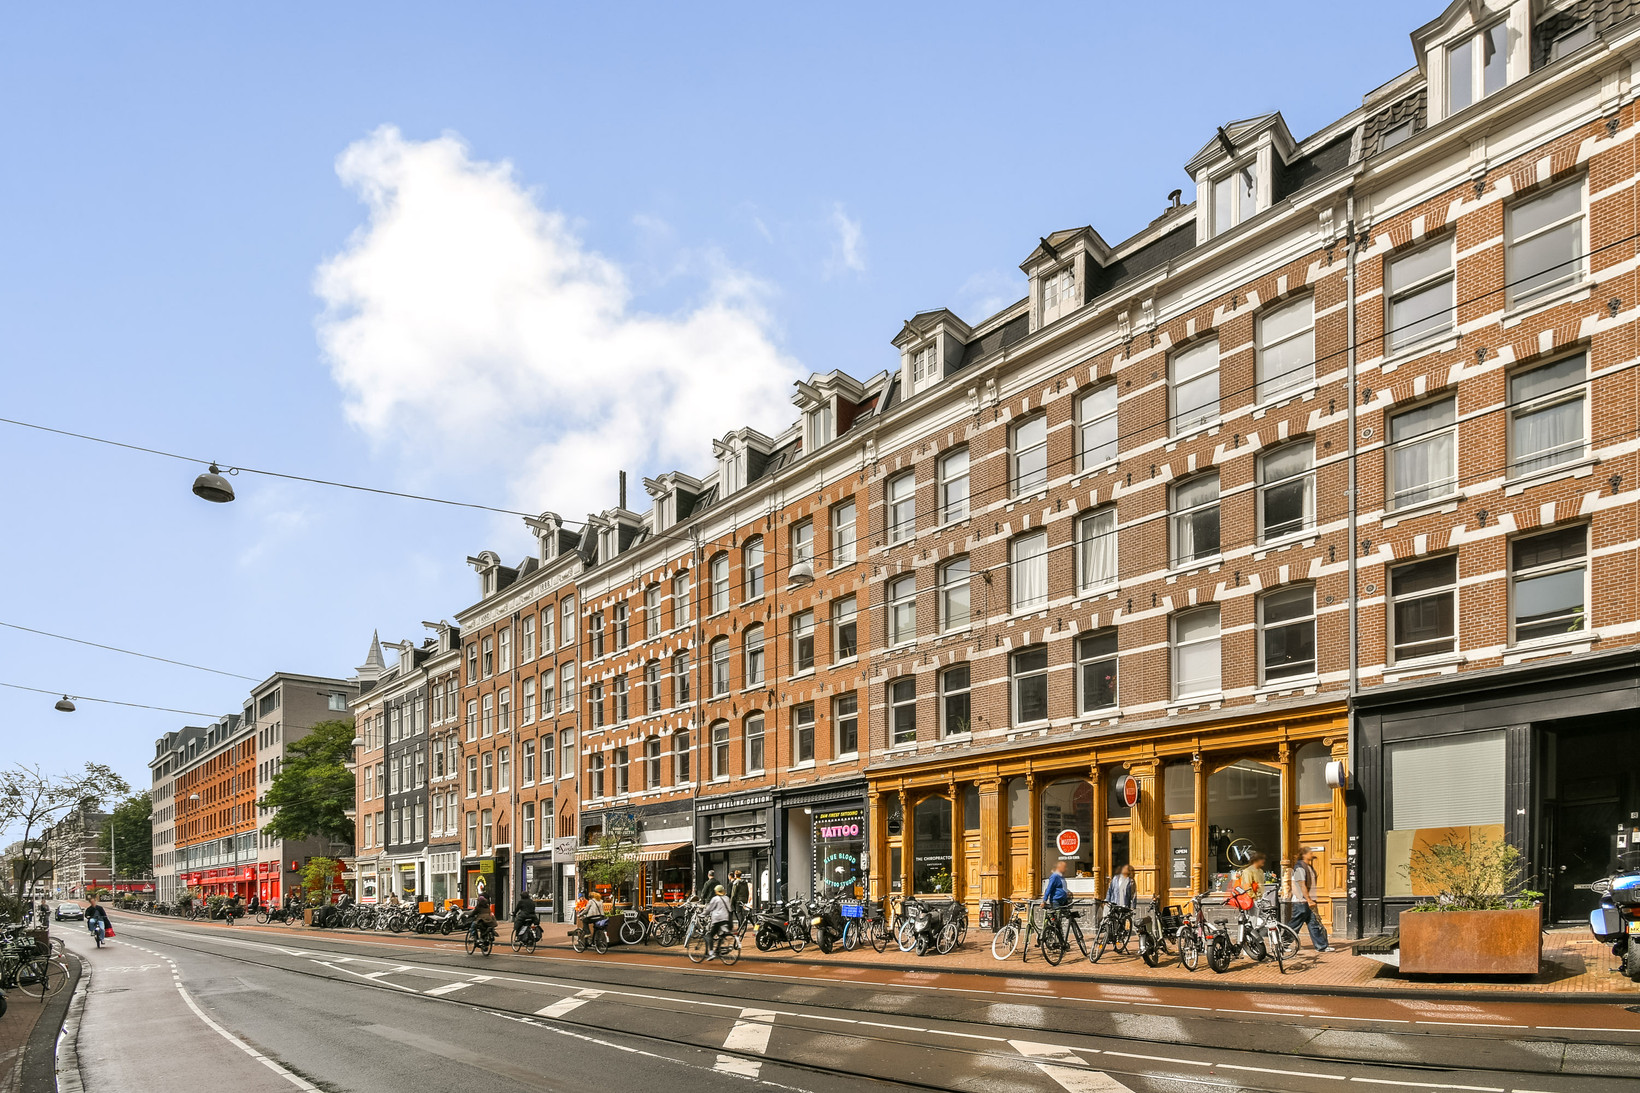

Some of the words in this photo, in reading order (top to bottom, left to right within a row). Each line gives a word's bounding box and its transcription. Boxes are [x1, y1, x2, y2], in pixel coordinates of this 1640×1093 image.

[747, 796, 769, 804] DESIGN
[820, 824, 859, 838] TATTOO
[824, 853, 837, 864] BLUE
[839, 853, 856, 864] BLOOD
